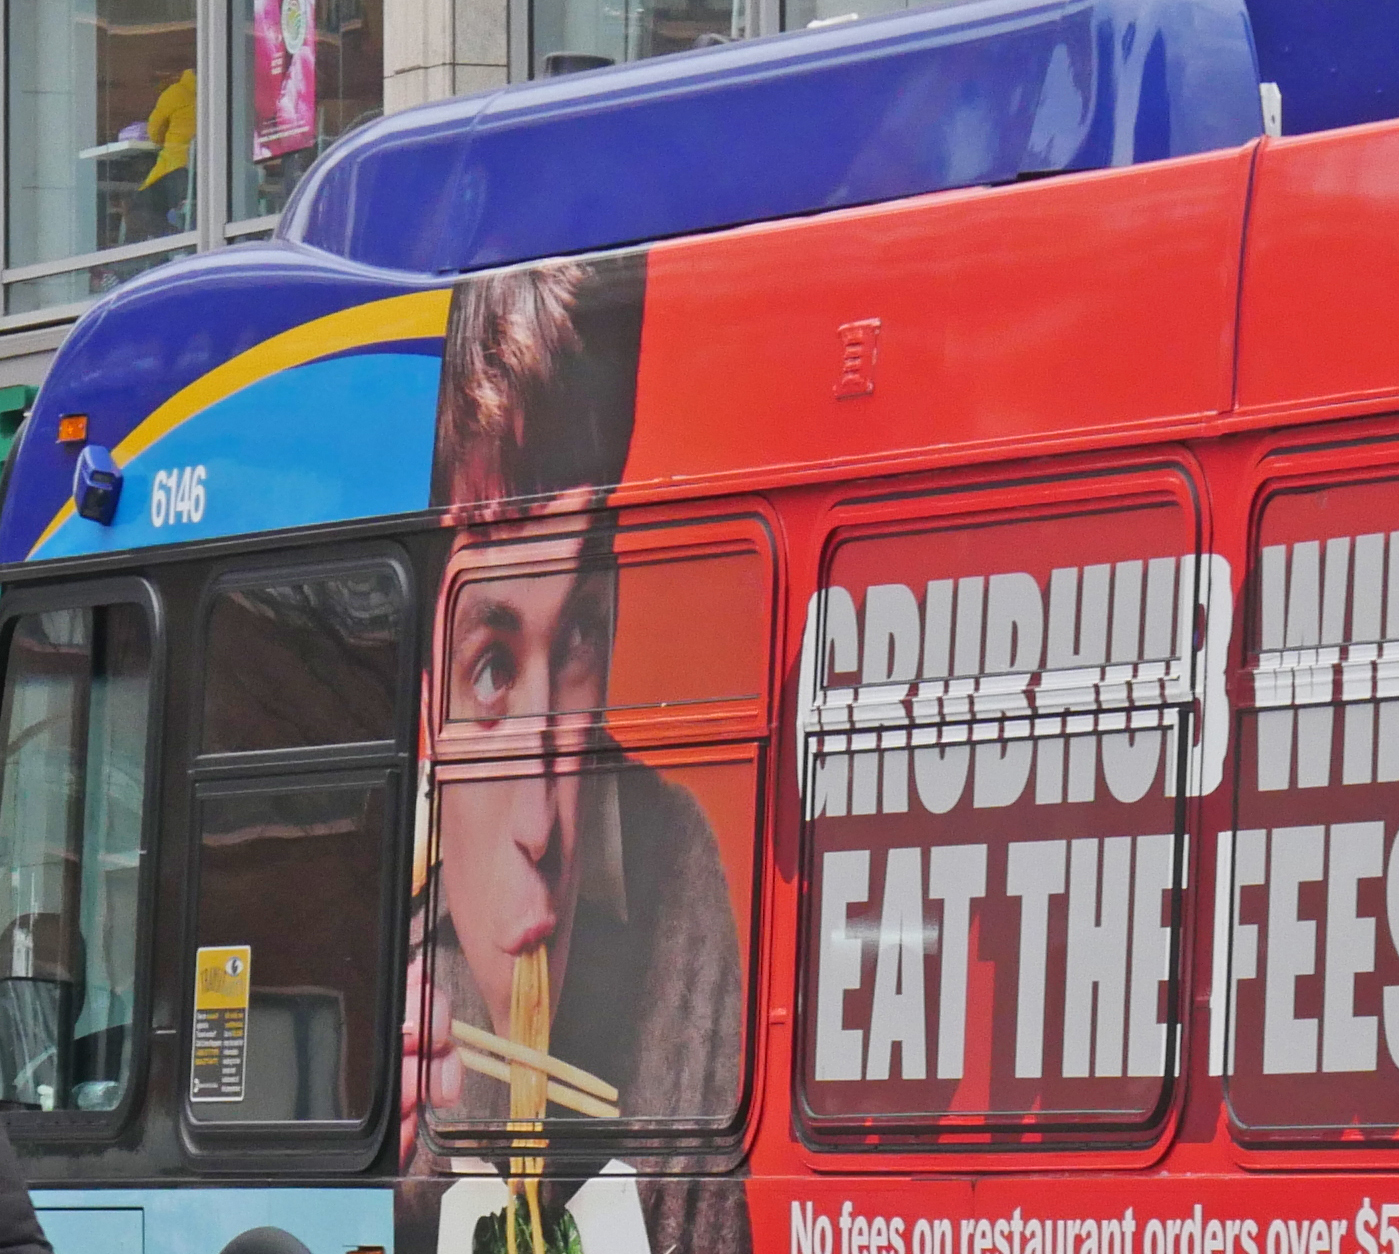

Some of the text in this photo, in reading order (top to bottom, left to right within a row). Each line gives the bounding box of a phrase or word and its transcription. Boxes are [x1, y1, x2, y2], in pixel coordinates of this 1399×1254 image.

[150, 464, 207, 528] 6146
[797, 553, 1232, 822] GRUBHUB
[814, 843, 988, 1081] EAT
[1006, 832, 1191, 1079] THE
